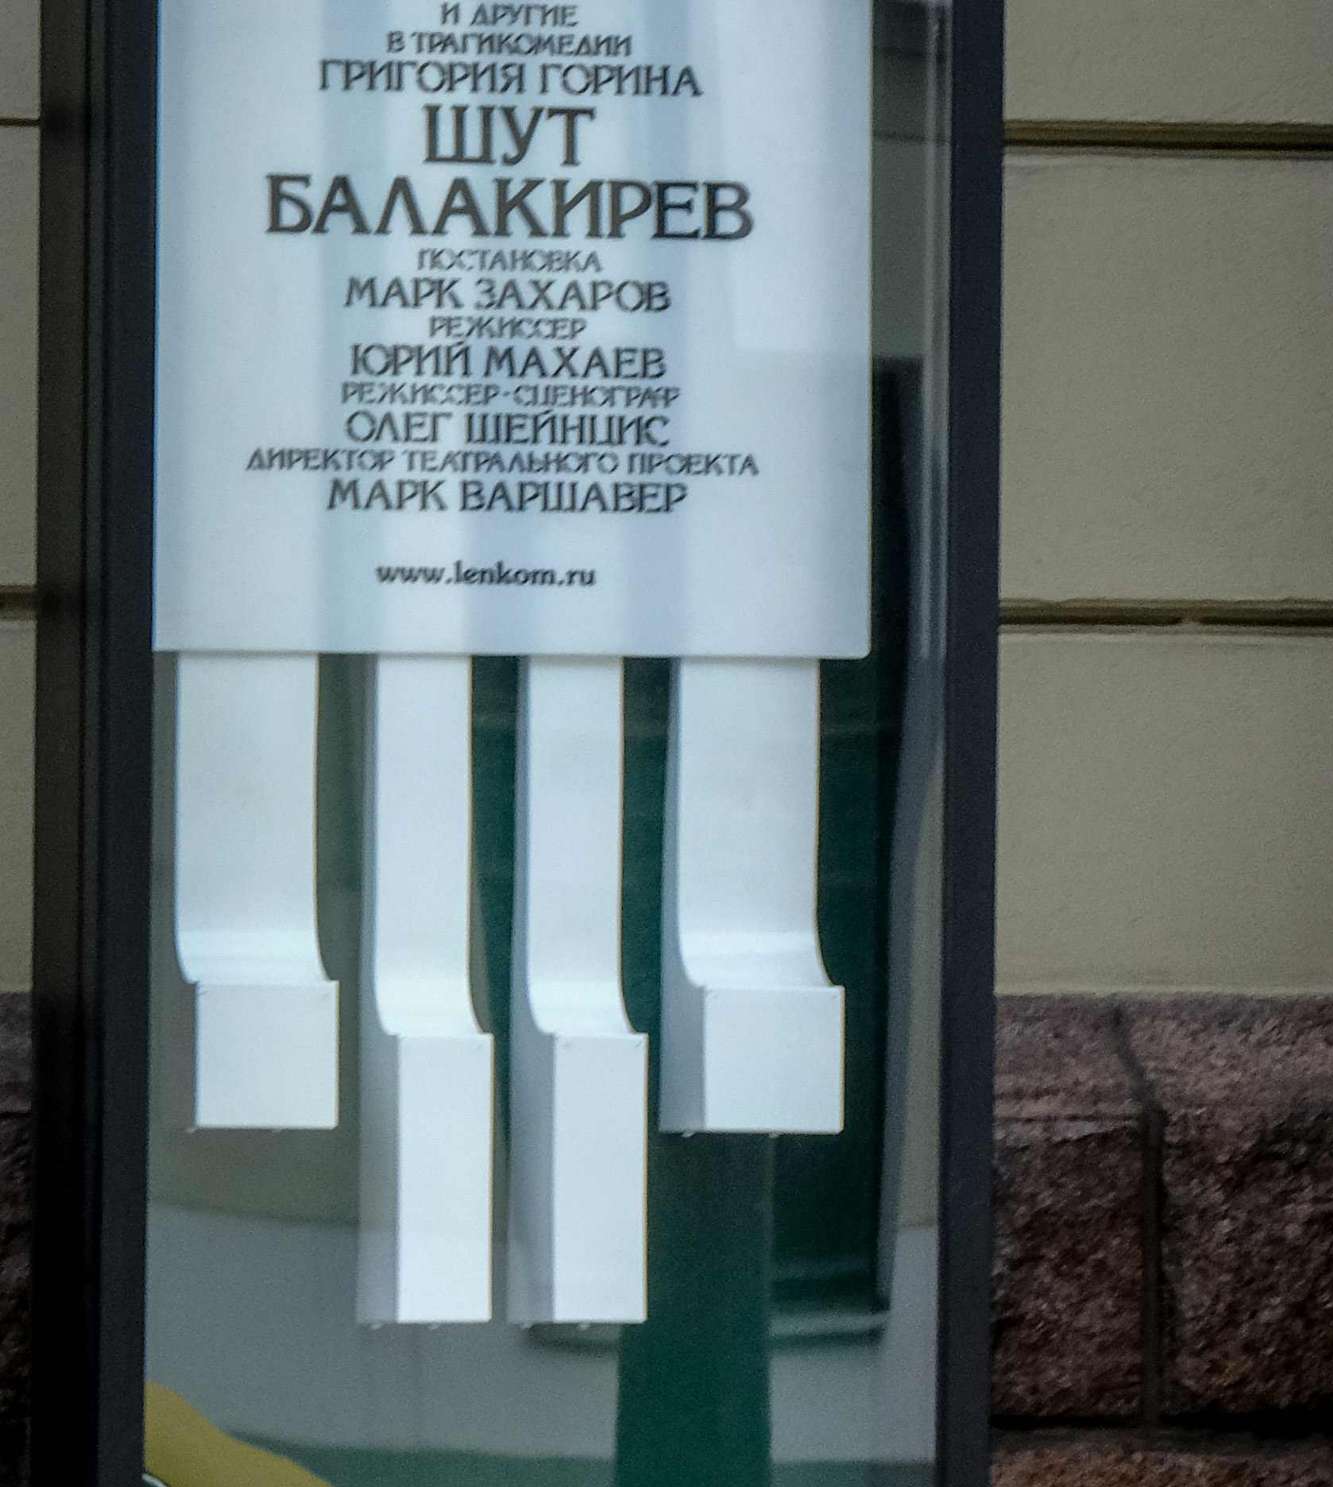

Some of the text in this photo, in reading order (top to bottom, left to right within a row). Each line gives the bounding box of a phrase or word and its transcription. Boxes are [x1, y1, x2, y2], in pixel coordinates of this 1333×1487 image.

[440, 2, 578, 27] И ДРУГИЕ
[387, 31, 632, 57] В ТРАГИКОМЕДИИ
[320, 59, 704, 97] ГРИГОРИЯ ГОРИНА
[423, 104, 596, 167] ШУТ
[266, 174, 754, 241] БАЛАКИРЕВ
[418, 248, 603, 272] ПОСТАНОВКА
[344, 277, 672, 313] МАРК ЗАХАРОВ
[429, 316, 586, 340] РЕЖИССЕР
[351, 340, 666, 380] ЮРИЙ МАХАЕВ
[341, 381, 680, 409] РЕЖИССЕР-СЦЕНОГРАФ
[346, 409, 670, 448] ОЛЕГ ШЕЙНЦИС
[246, 448, 759, 476] ДИРЕКТОР ТЕАТРАЛЬНОГО ПРОЕКТА
[327, 478, 687, 513] МАРК ВАРШАВЕР
[376, 560, 596, 586] www.lenkom.ru
